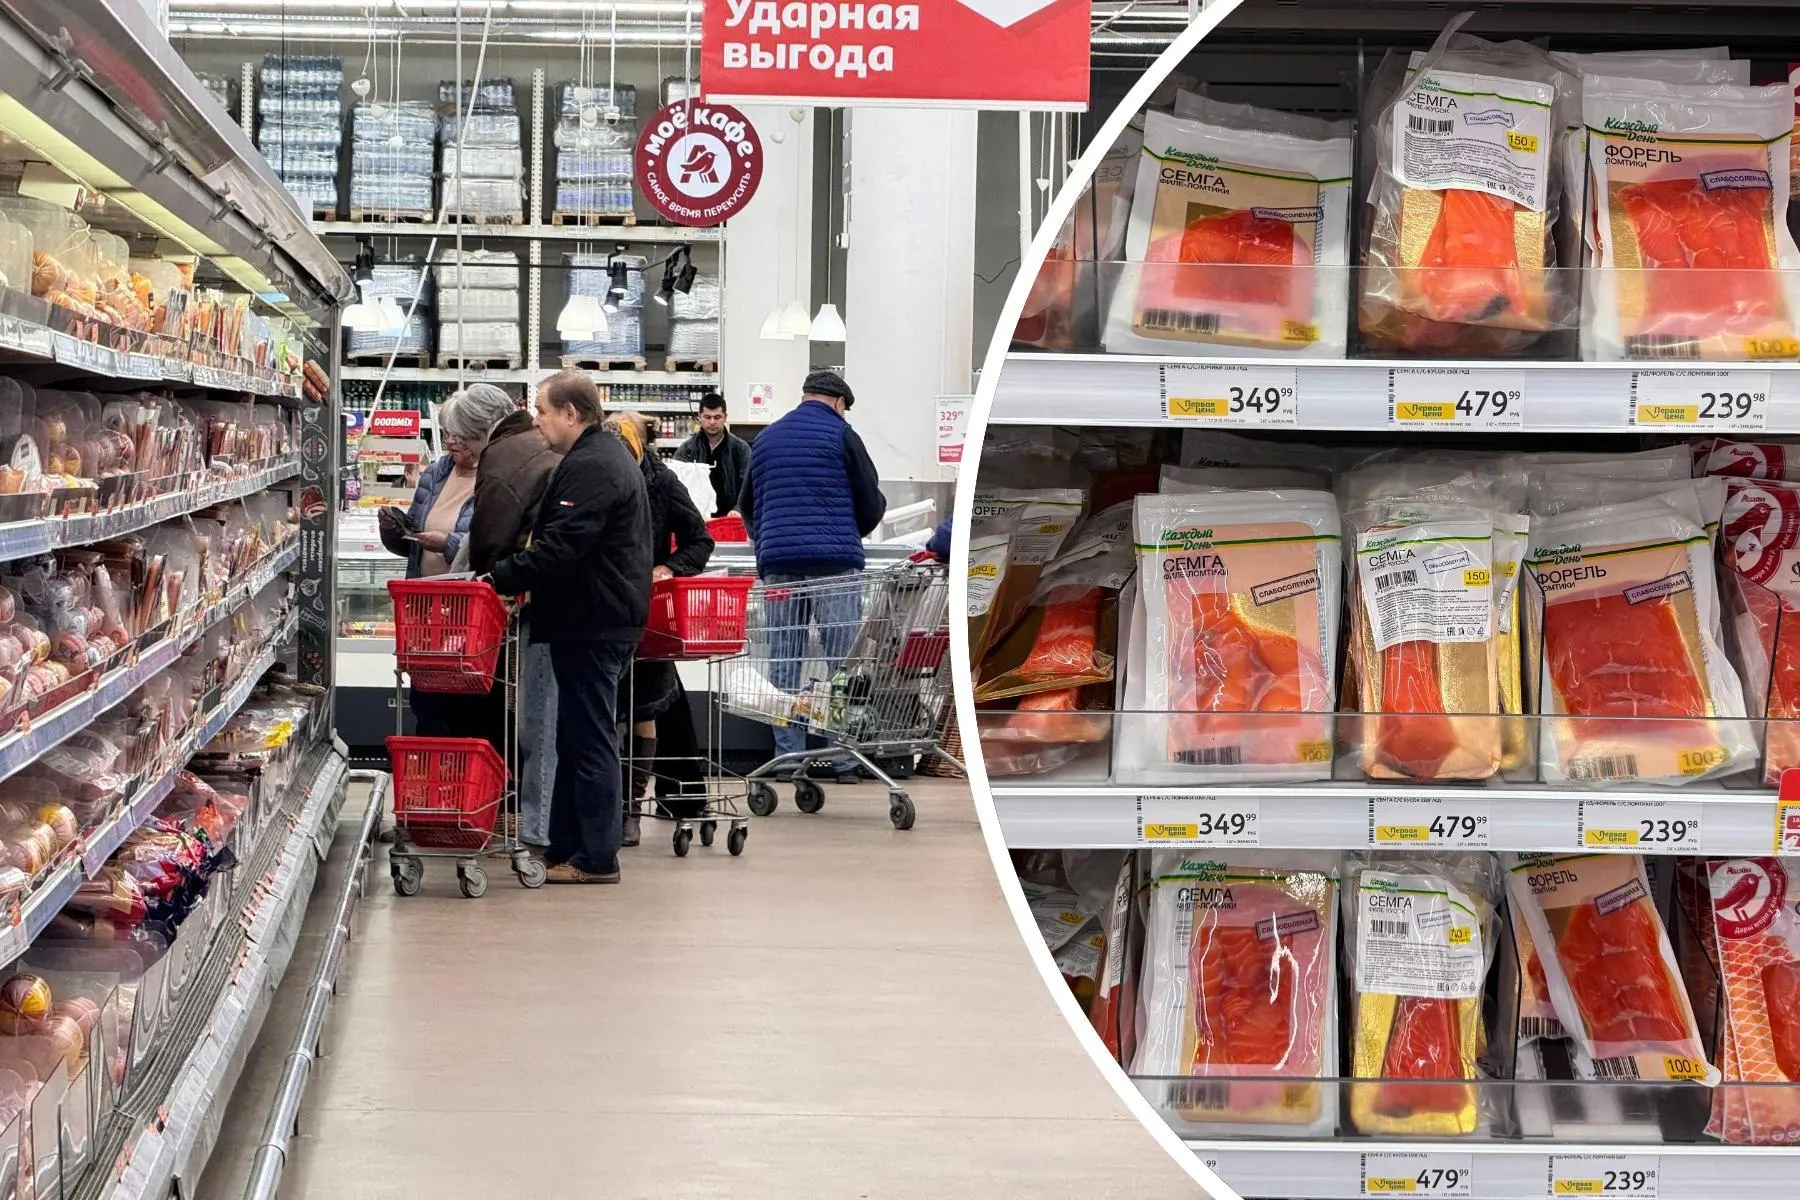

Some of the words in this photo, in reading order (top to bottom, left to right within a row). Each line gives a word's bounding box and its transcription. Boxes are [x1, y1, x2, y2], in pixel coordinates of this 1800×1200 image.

[723, 0, 919, 39] Ударная
[722, 41, 893, 78] выгода
[1408, 91, 1458, 109] СЕМГА
[1508, 135, 1528, 146] 150
[1627, 132, 1657, 144] День
[1604, 146, 1682, 164] ФОРЕЛЬ
[1604, 157, 1648, 168] ЛОМТИКИ
[1186, 159, 1216, 171] День
[1160, 178, 1230, 195] ФИЛЕ-ЛОМТИКИ
[1161, 168, 1226, 188] СЕМГА
[1709, 173, 1768, 184] СЛАБОСОЛЕНАЯ
[647, 171, 671, 205] САМОЕ
[667, 201, 701, 218] ВРЕМЯ
[703, 172, 751, 219] ПЕРЕКУСИТЬ
[1258, 210, 1317, 218] СЛАБОСОЛЕНАЯ
[1229, 387, 1280, 413] 349
[1281, 388, 1293, 397] 99
[1456, 391, 1508, 417] 479
[1509, 391, 1521, 400] 99
[1698, 393, 1752, 419] 239
[1753, 394, 1765, 402] 98
[374, 417, 414, 427] GOODMIX
[973, 506, 1009, 518] ОРЕЛ
[1162, 528, 1213, 542] Каждый
[1184, 540, 1213, 551] День
[1163, 555, 1224, 573] СЕМГА
[1369, 549, 1416, 567] СЕМГА
[1554, 553, 1581, 565] День
[1163, 569, 1229, 580] ФИЛЕ-ЛОМТИКИ
[1467, 571, 1485, 581] 150
[1536, 565, 1607, 586] ФОРЕЛЬ
[1259, 577, 1316, 598] СЛАБОСОЛЕНАЯ
[1542, 581, 1576, 593] ОМТИКИ
[1631, 578, 1686, 599] СЛАБОСОЛЕНАЯ
[1682, 750, 1714, 767] 100
[1199, 813, 1246, 835] 349
[1246, 813, 1257, 821] 99
[1429, 816, 1476, 838] 479
[1640, 820, 1687, 842] 239
[1687, 820, 1698, 828] 98
[1533, 858, 1556, 868] День
[1527, 870, 1578, 888] ФОРЕЛЬ
[1178, 887, 1233, 902] СЕМГА
[1531, 886, 1558, 896] ЛОМТИКИ
[1600, 886, 1640, 910] СЛАБОСОЛЕНАЯ
[1369, 895, 1412, 908] СЕМГА
[1668, 1058, 1692, 1073] 100
[1205, 1159, 1216, 1167] 99
[1416, 1169, 1459, 1189] 479
[1603, 1170, 1646, 1190] 239
